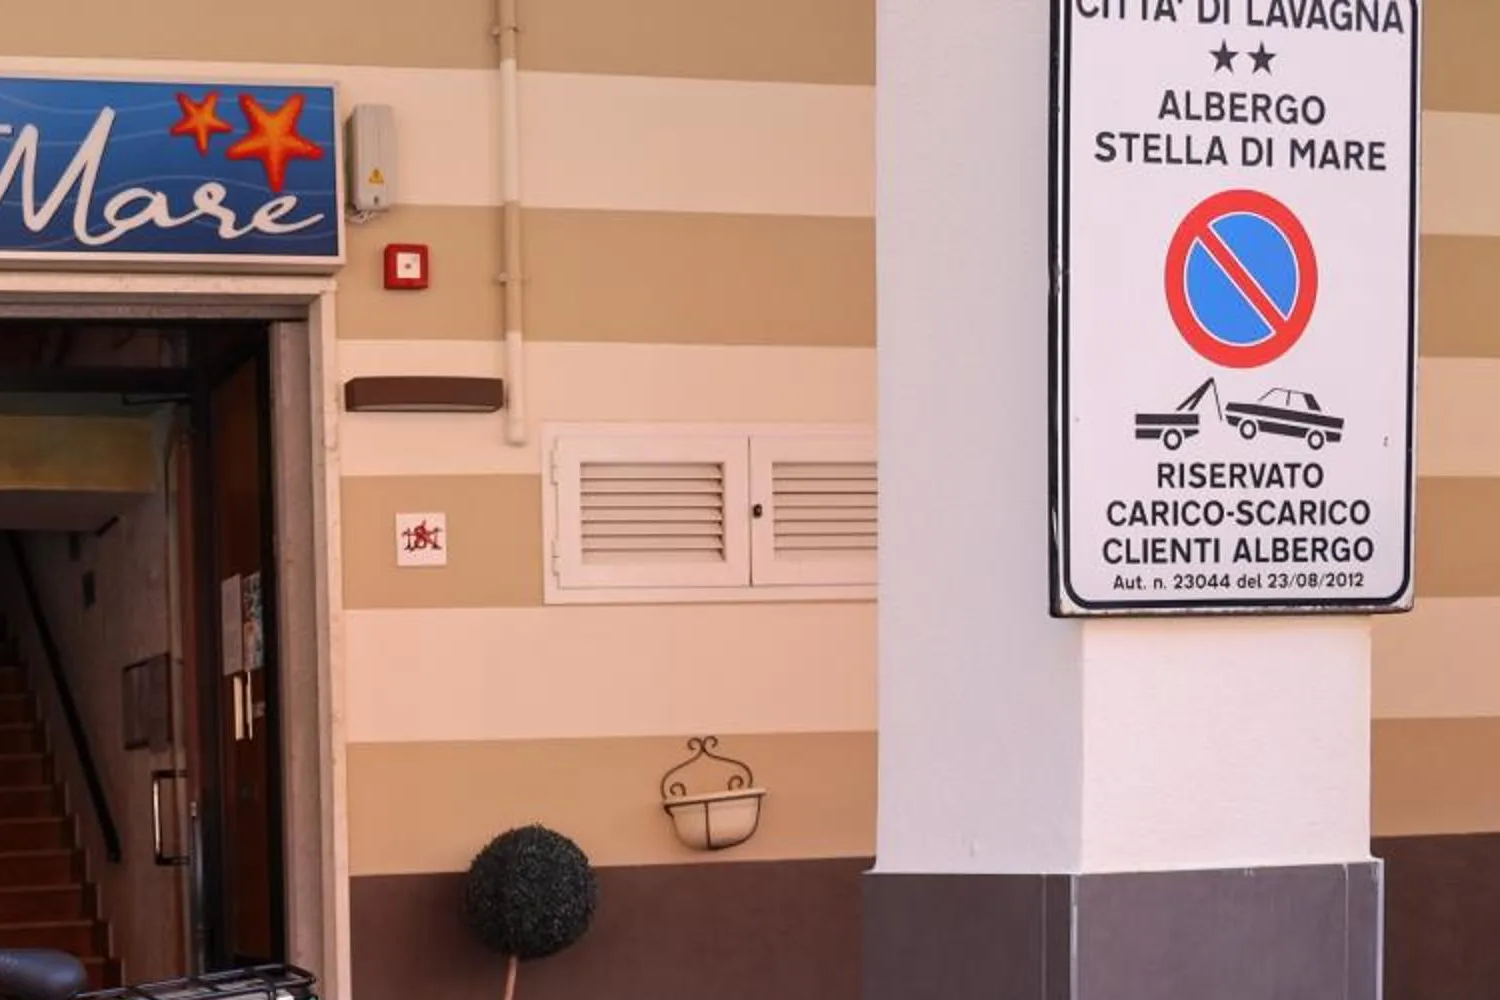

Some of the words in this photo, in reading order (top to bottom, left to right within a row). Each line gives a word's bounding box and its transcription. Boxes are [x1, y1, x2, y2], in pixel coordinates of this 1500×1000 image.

[1198, 0, 1231, 24] DI
[1247, 0, 1404, 34] LAVAGNA
[1157, 89, 1327, 126] ALBERGO
[1094, 131, 1229, 167] STELLA
[1241, 136, 1274, 168] DI
[1289, 138, 1388, 172] MARE
[1156, 462, 1325, 489] RISERVATO
[1106, 499, 1372, 527] CARICO-SCARICO
[1102, 537, 1221, 565] CLIENTI
[1232, 536, 1376, 564] ALBERGO
[1113, 574, 1147, 591] Aut.
[1153, 578, 1168, 590] n.
[1172, 573, 1231, 590] 23044
[1237, 573, 1263, 589] del
[1267, 572, 1365, 590] 23/08/2012
